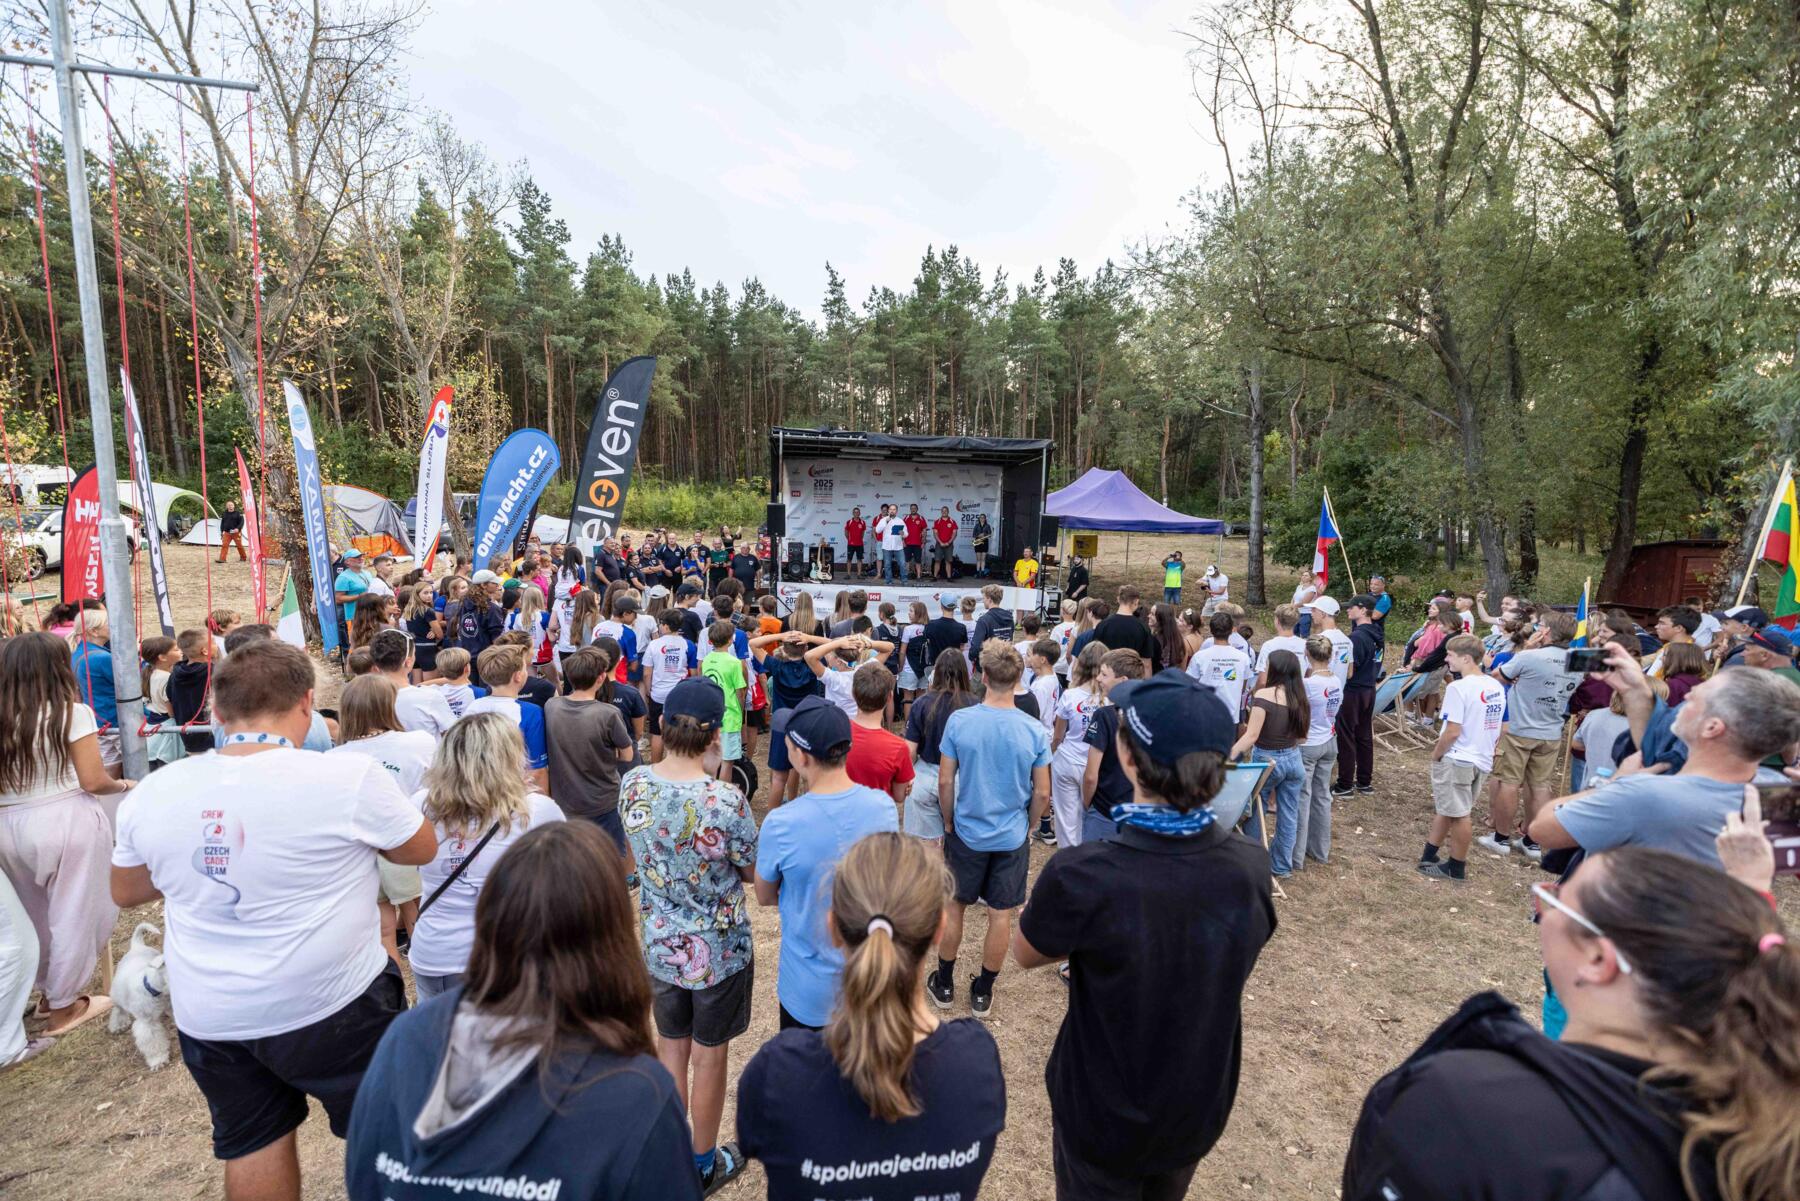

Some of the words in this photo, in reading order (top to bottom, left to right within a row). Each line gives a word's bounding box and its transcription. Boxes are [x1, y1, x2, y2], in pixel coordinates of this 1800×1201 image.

[813, 479, 834, 488] 2025
[477, 444, 548, 558] oneyacht.cz
[504, 494, 531, 536] WINDSURFING
[530, 458, 555, 492] EQUIPMENT
[1327, 698, 1340, 706] 2025
[1486, 704, 1502, 714] 2025
[201, 810, 225, 820] CREW
[204, 846, 230, 855] CZECH
[204, 857, 230, 866] CADET
[205, 866, 227, 875] TEAM
[801, 1140, 981, 1185] #spolunajednelodi
